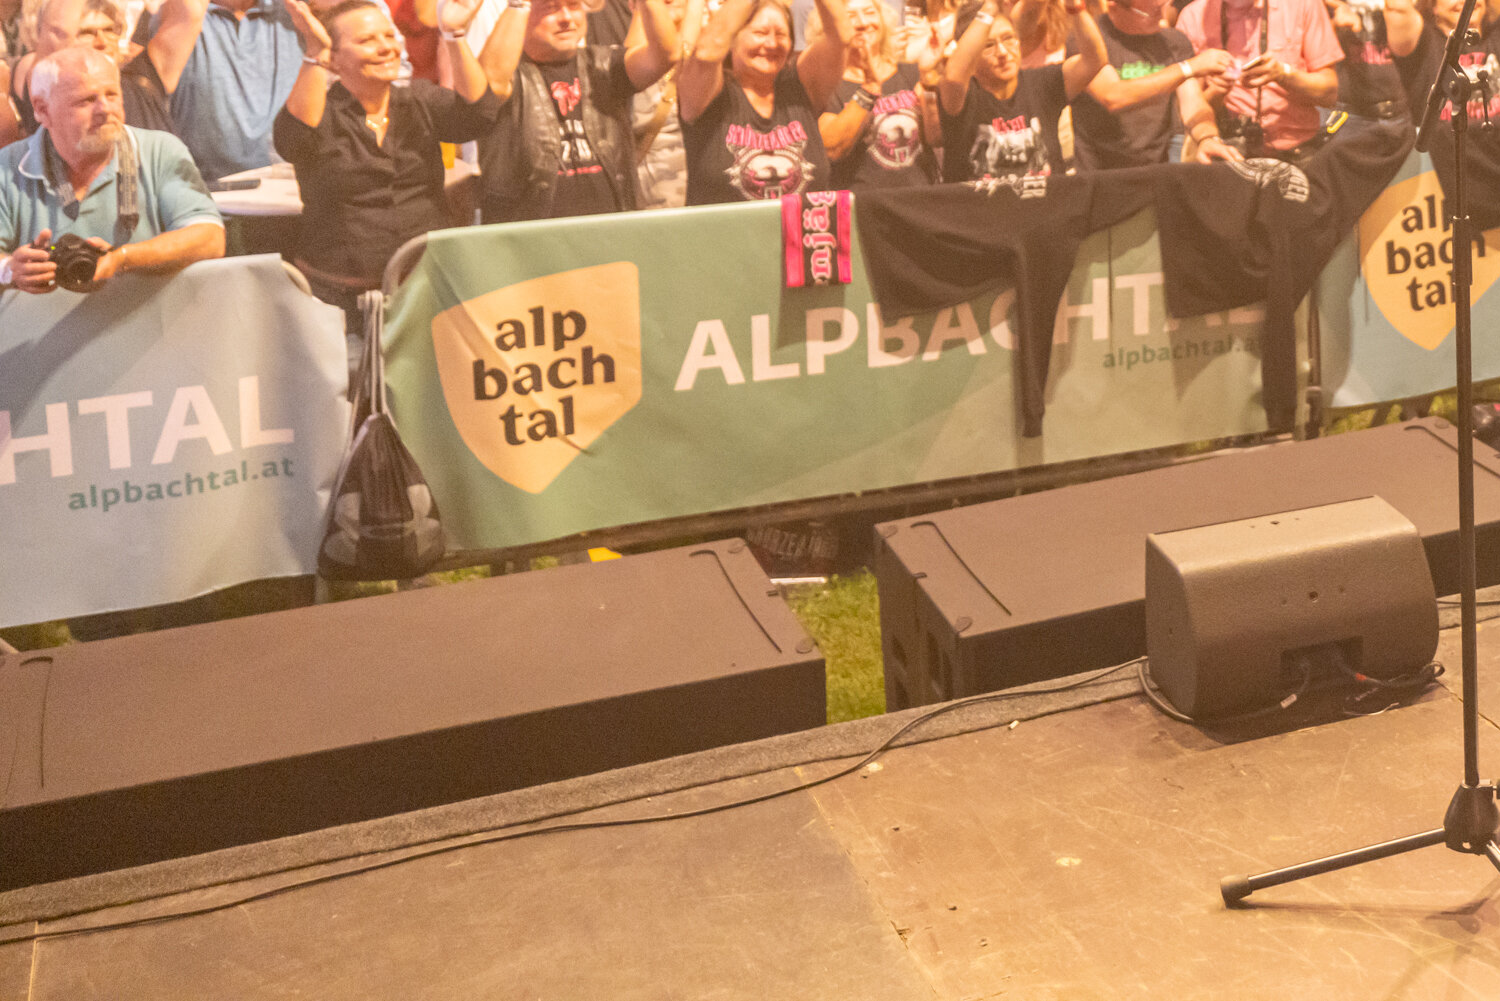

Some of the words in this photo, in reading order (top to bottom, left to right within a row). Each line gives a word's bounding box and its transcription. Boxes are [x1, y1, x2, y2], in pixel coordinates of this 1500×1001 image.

[495, 305, 587, 352] alp
[1103, 333, 1261, 371] alpbachtal.a
[472, 345, 616, 401] bach
[499, 395, 575, 446] tal
[68, 457, 295, 513] alpbachtal.at
